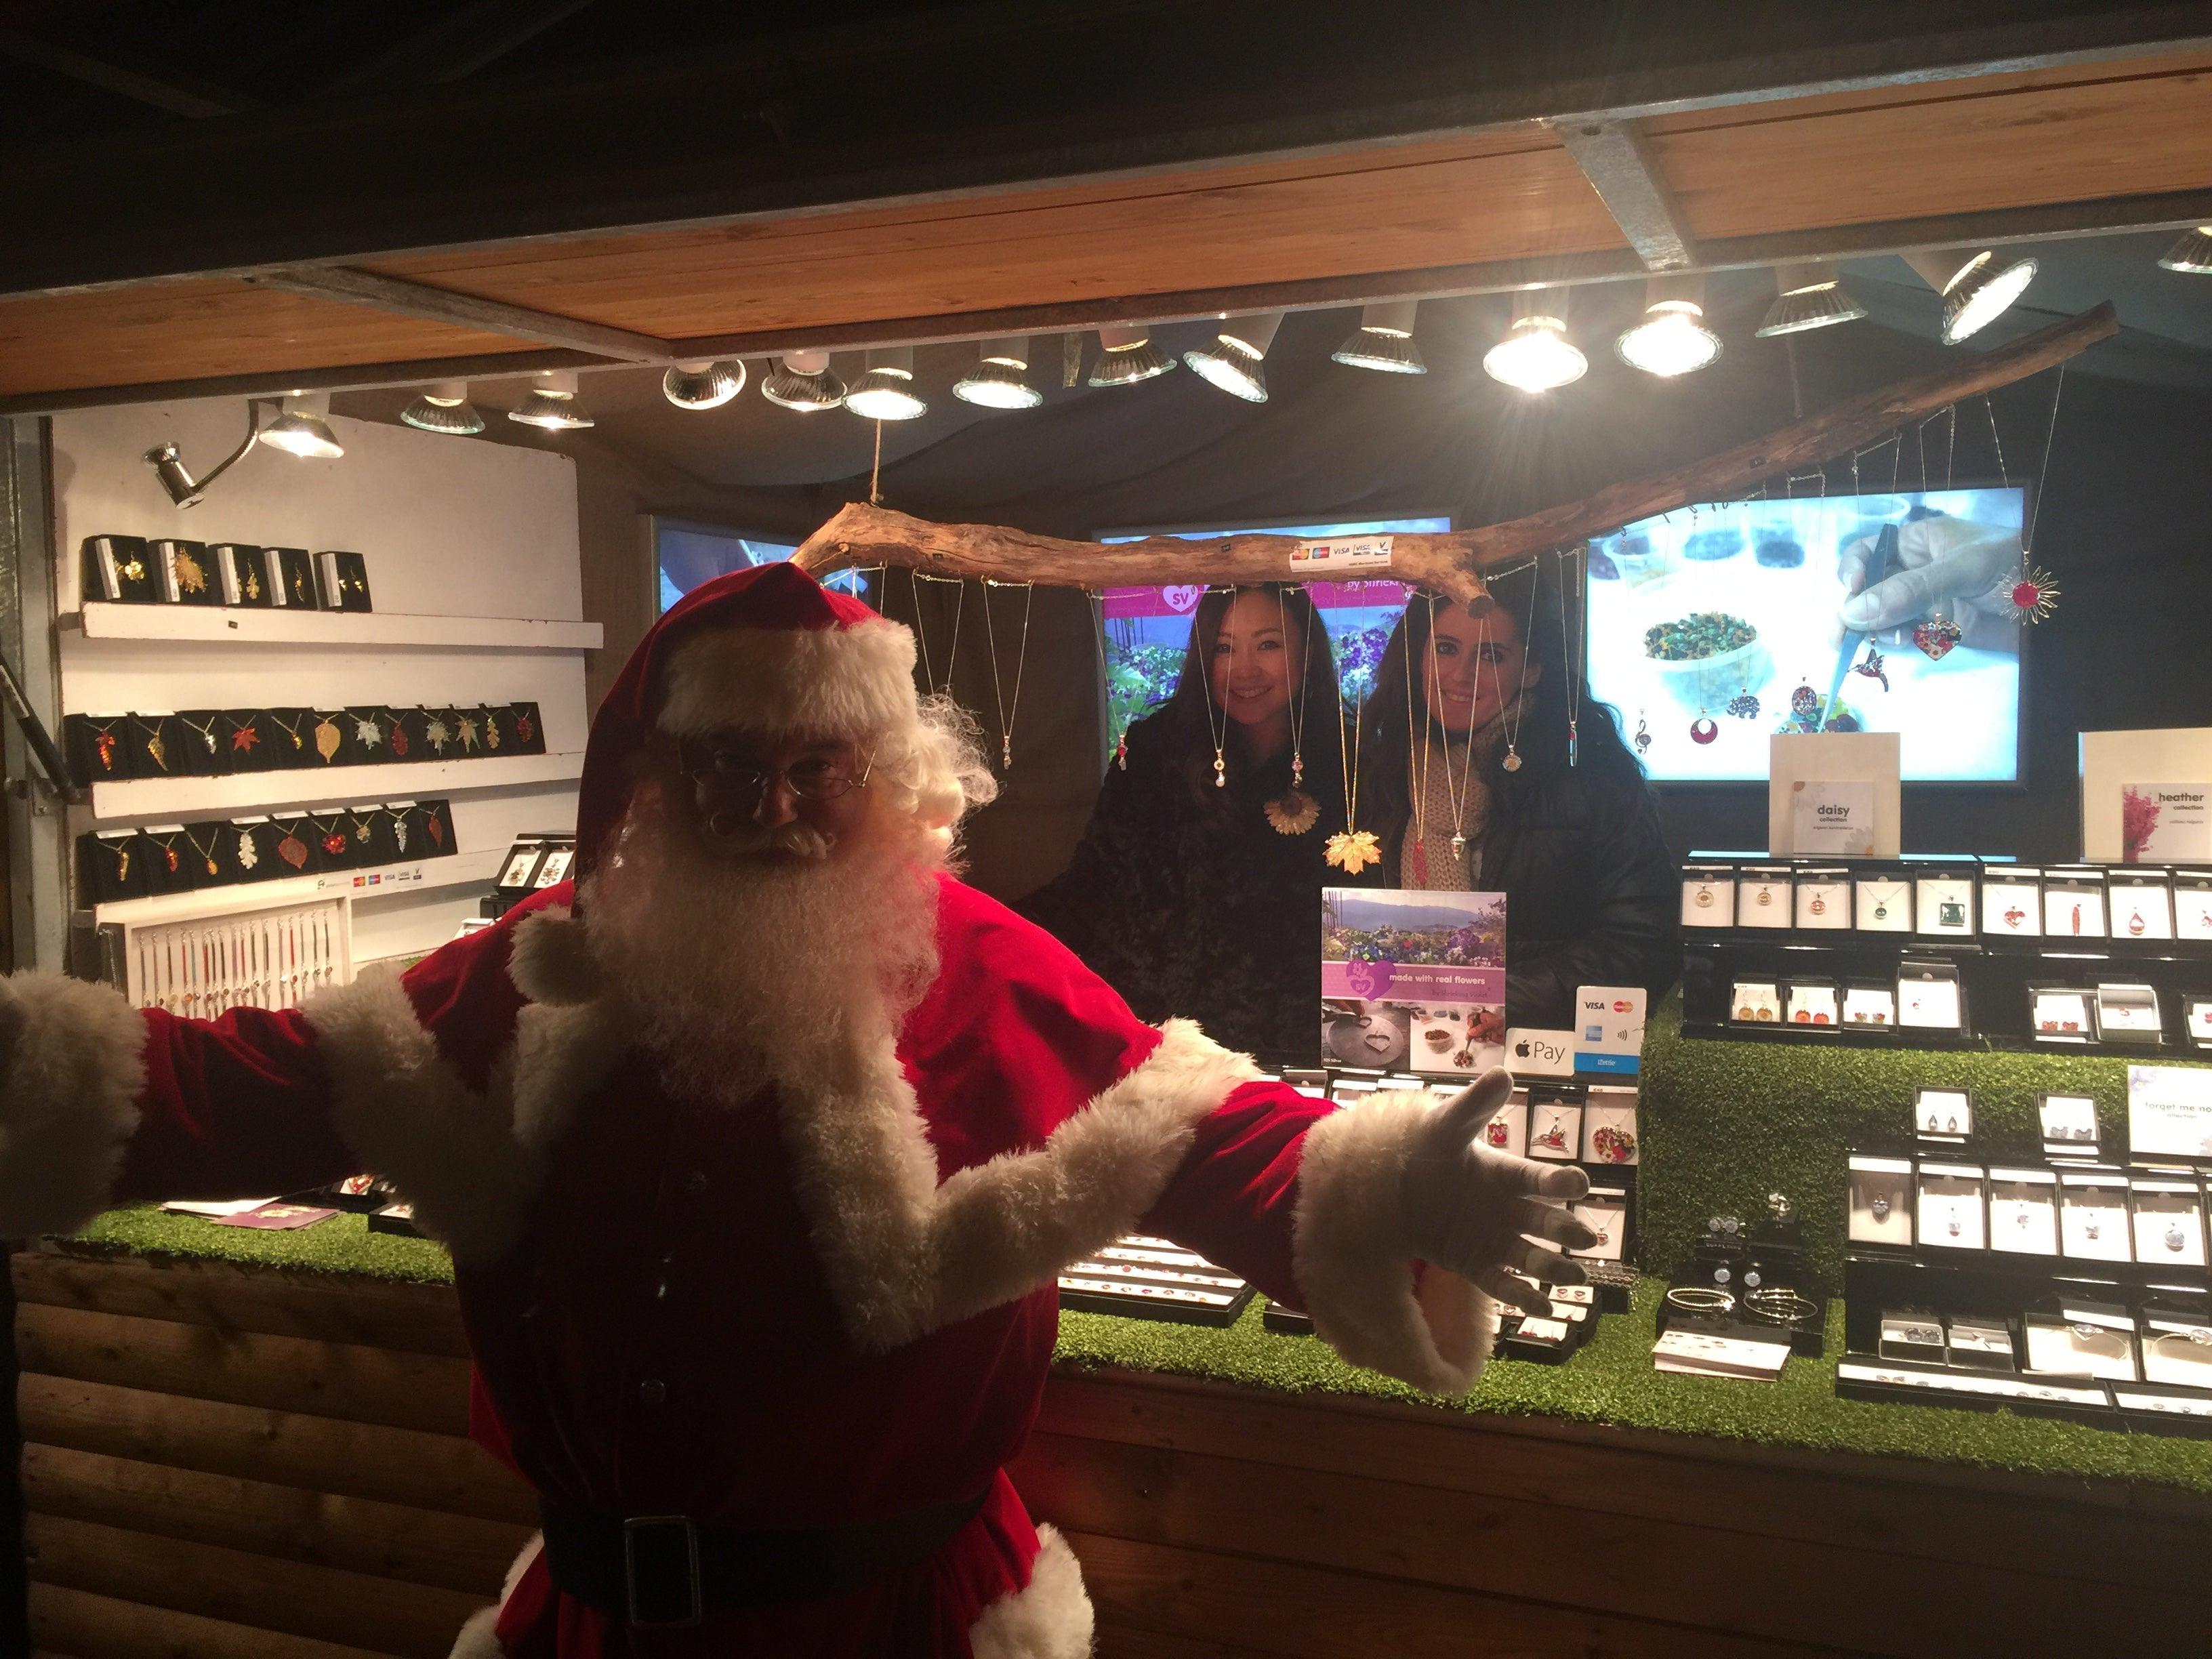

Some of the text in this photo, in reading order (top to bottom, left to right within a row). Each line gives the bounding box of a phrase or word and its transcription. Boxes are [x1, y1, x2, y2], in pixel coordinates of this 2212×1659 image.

[1173, 593, 1189, 605] SV
[2158, 792, 2205, 802] heather
[1817, 804, 1850, 817] daisy
[1389, 974, 1486, 985] made with real flowers
[1584, 1002, 1605, 1010] VISA
[1534, 1042, 1565, 1065] Pay
